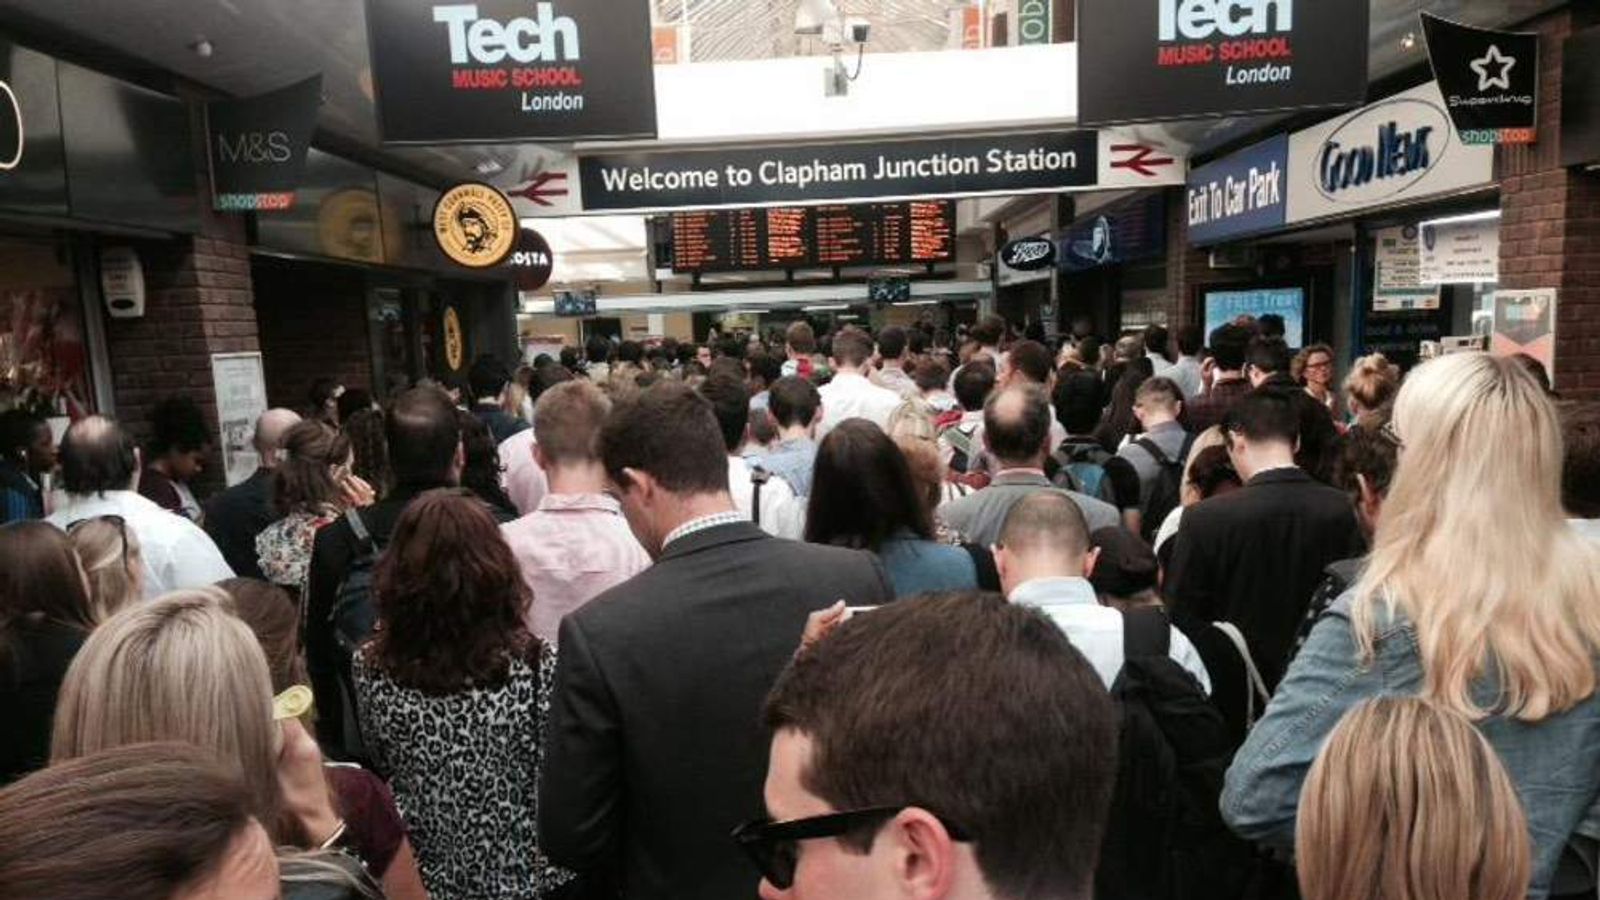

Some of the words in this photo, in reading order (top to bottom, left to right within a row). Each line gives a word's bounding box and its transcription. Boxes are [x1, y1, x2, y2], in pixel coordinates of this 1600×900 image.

[433, 2, 580, 63] Tech
[1158, 44, 1214, 65] MUSIC
[1219, 38, 1291, 60] SCHOOL
[452, 68, 508, 88] MUSIC
[511, 66, 582, 86] SCHOOL
[1226, 63, 1292, 85] London
[522, 91, 583, 111] London
[219, 131, 291, 162] M&S
[601, 166, 719, 191] Welcome
[725, 164, 752, 186] to
[759, 159, 867, 189] Clapham
[873, 153, 980, 180] Junction
[986, 147, 1076, 173] Station
[1188, 188, 1208, 226] Exit
[1209, 181, 1222, 219] To
[1225, 175, 1246, 217] Car
[1249, 161, 1280, 210] Park
[509, 252, 549, 266] OSTA
